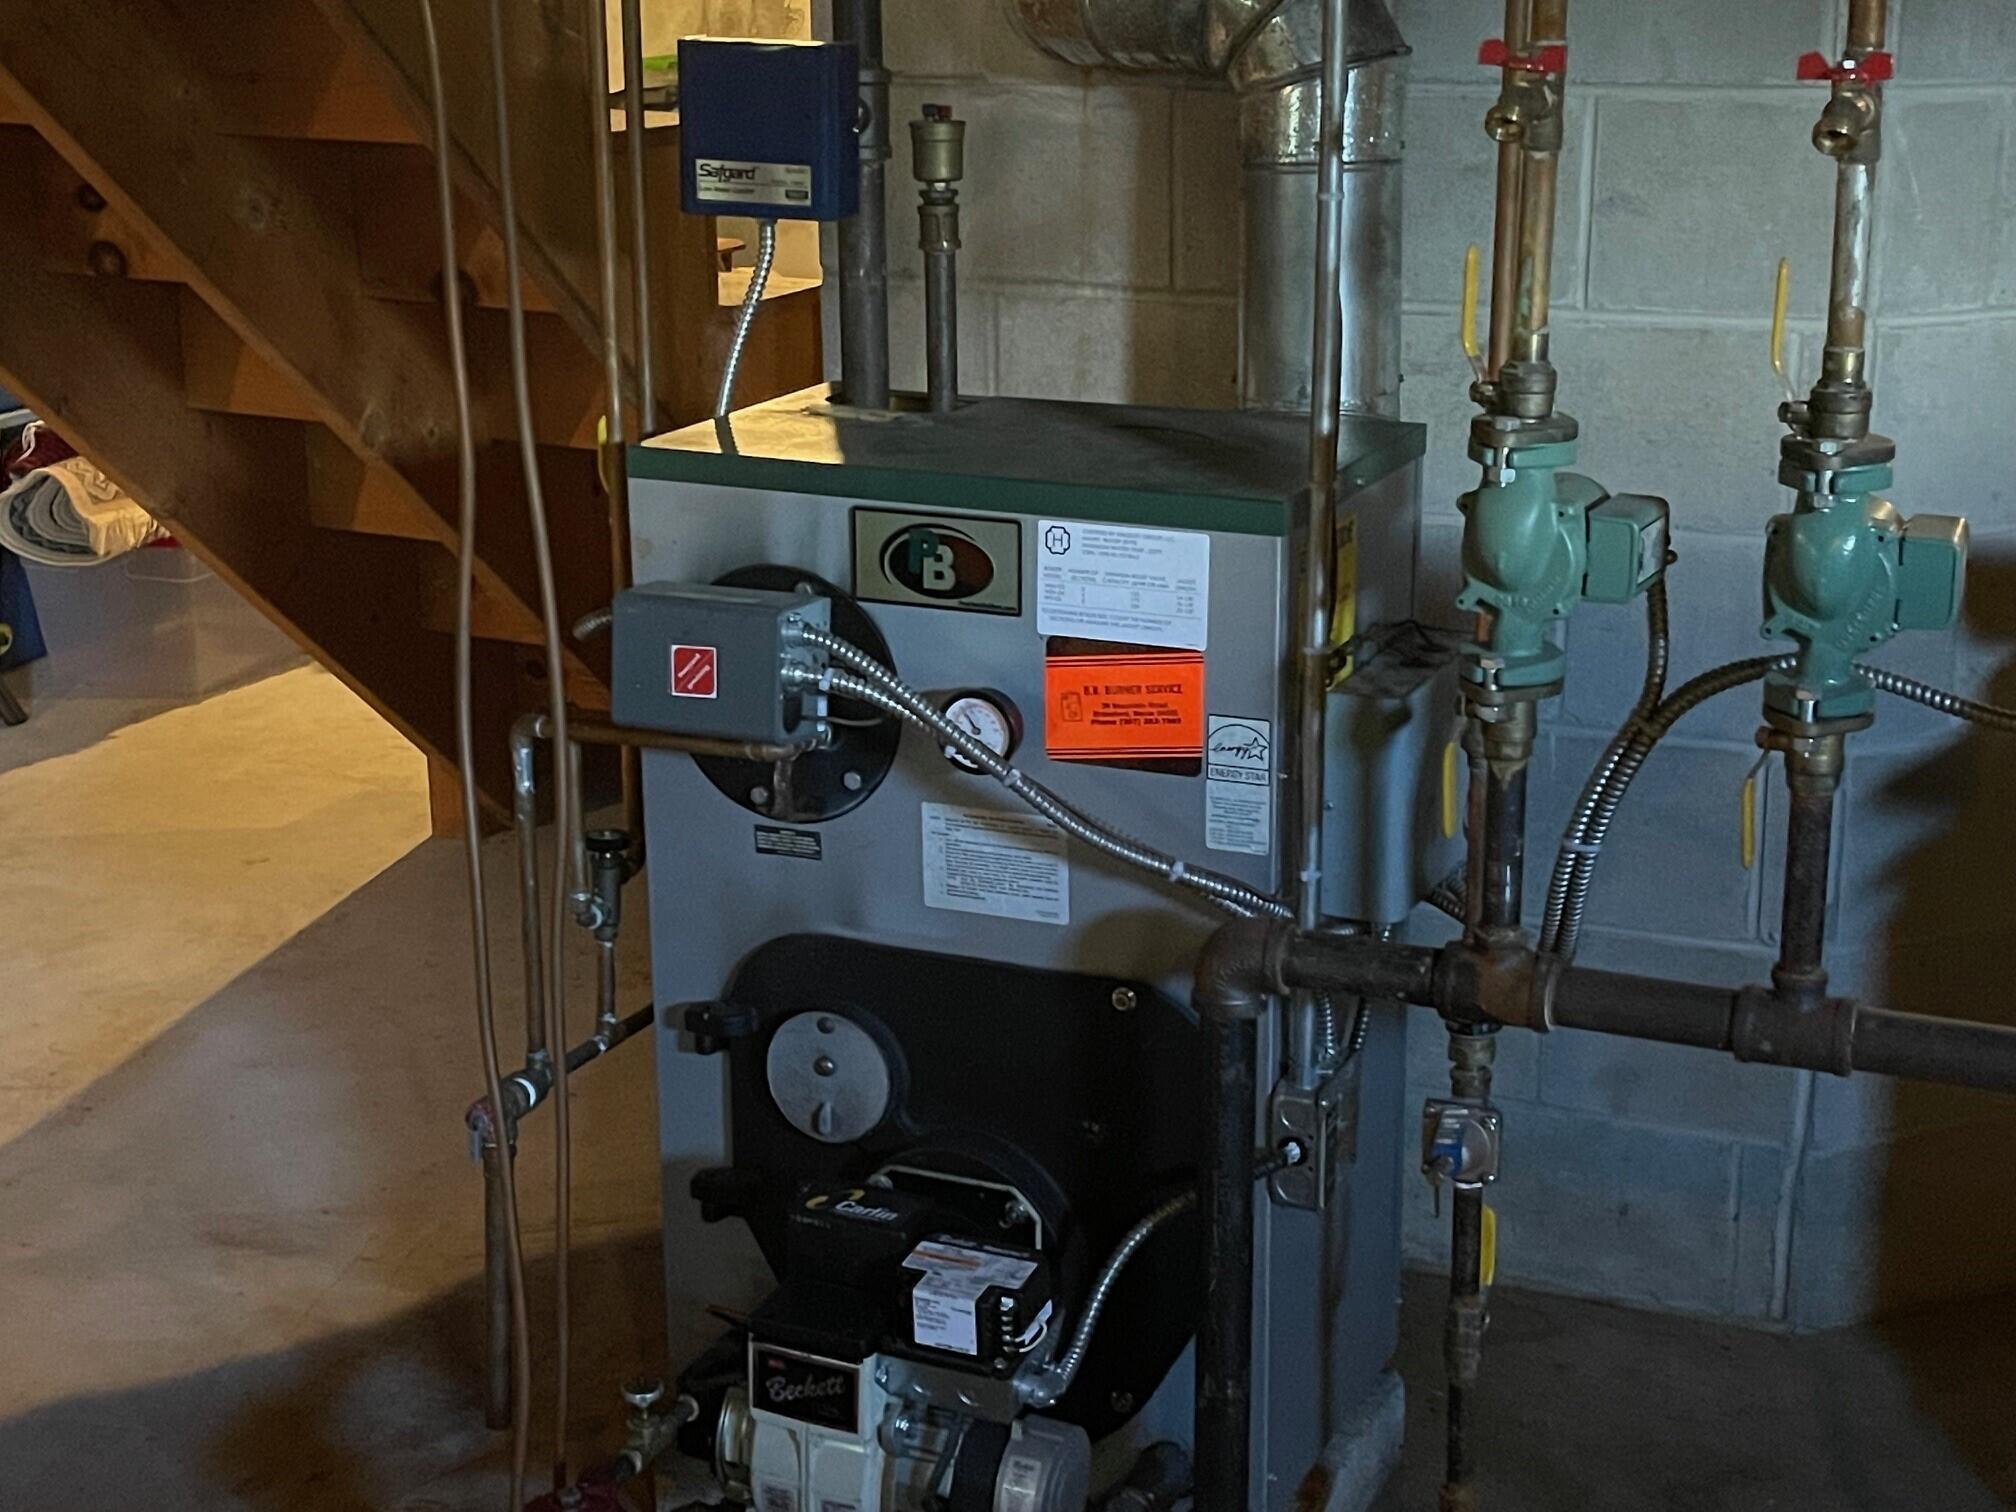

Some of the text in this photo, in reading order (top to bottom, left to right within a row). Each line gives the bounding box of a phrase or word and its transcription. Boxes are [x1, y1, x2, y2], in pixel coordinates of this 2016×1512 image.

[1210, 768, 1266, 782] ENERGY STAR
[835, 1200, 899, 1221] Carlin
[765, 1374, 846, 1402] Beckett
